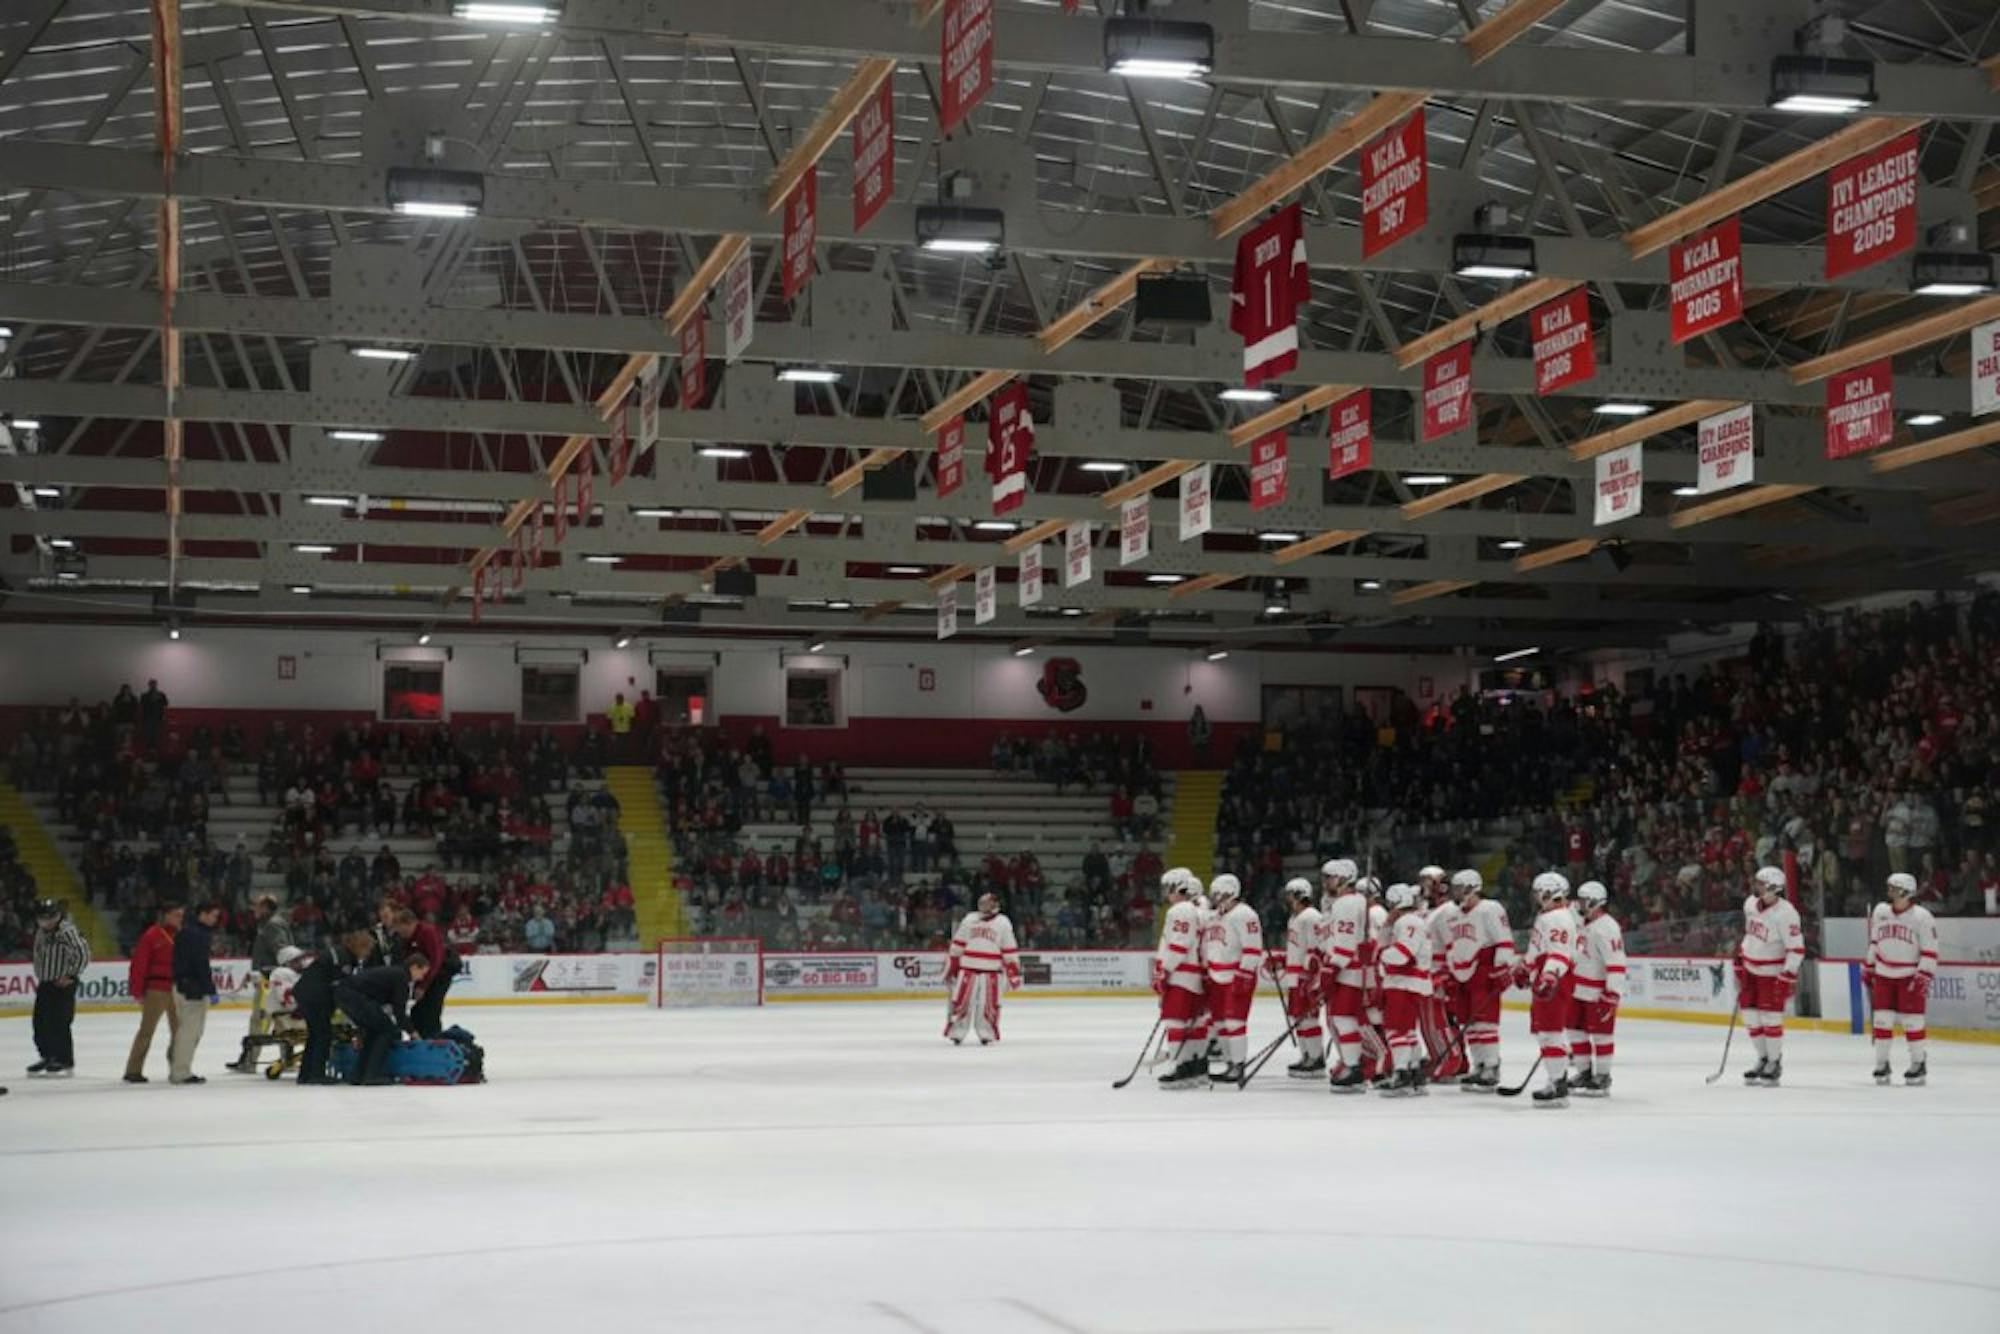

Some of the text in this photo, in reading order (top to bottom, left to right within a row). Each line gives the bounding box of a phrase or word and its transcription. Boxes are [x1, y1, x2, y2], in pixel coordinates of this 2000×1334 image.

[1371, 135, 1407, 179] NCAA
[1363, 155, 1422, 215] CHAMPIONS
[1832, 149, 1918, 209] IVY LEAGUE
[1379, 196, 1407, 236] 1967
[1832, 179, 1916, 235] CHAMPIONS
[1853, 215, 1896, 254] 2005
[1682, 236, 1720, 273] NCAA
[1671, 256, 1739, 304] TOURNAMENT
[1541, 304, 1573, 335] NCAA
[1685, 291, 1721, 324] 2005
[1844, 377, 1874, 402] NCAA
[1828, 391, 1892, 425] TOURNAMENT
[1717, 416, 1751, 442] LEAGUE
[1701, 436, 1750, 465] CHAMPIONS
[1337, 920, 1354, 935] 22
[1406, 926, 1415, 938] 7
[802, 973, 819, 984] GO
[822, 972, 842, 984] BIG
